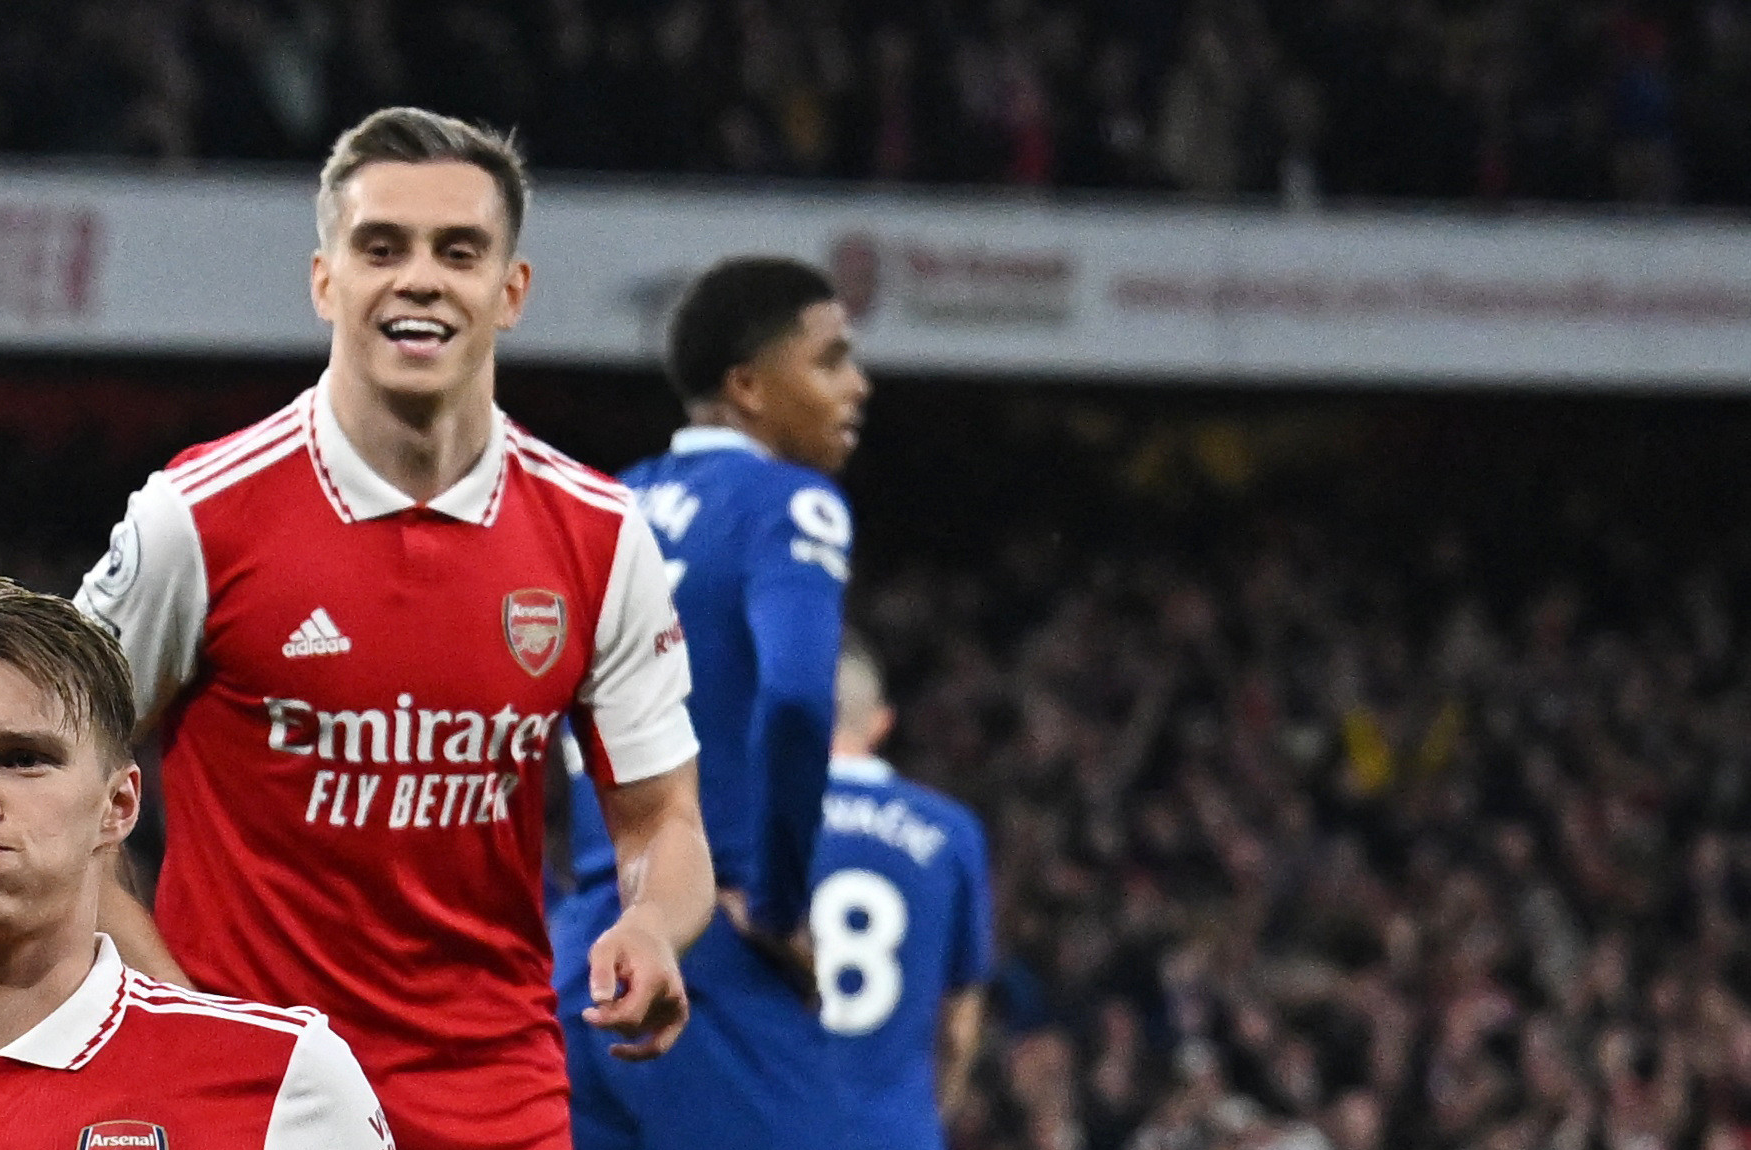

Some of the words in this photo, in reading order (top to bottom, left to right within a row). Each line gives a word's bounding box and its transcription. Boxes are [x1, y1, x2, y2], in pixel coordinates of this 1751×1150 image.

[305, 769, 381, 827] FLY
[388, 771, 520, 831] BETTER
[809, 868, 909, 1035] 8
[90, 1133, 155, 1147] Arsenal
